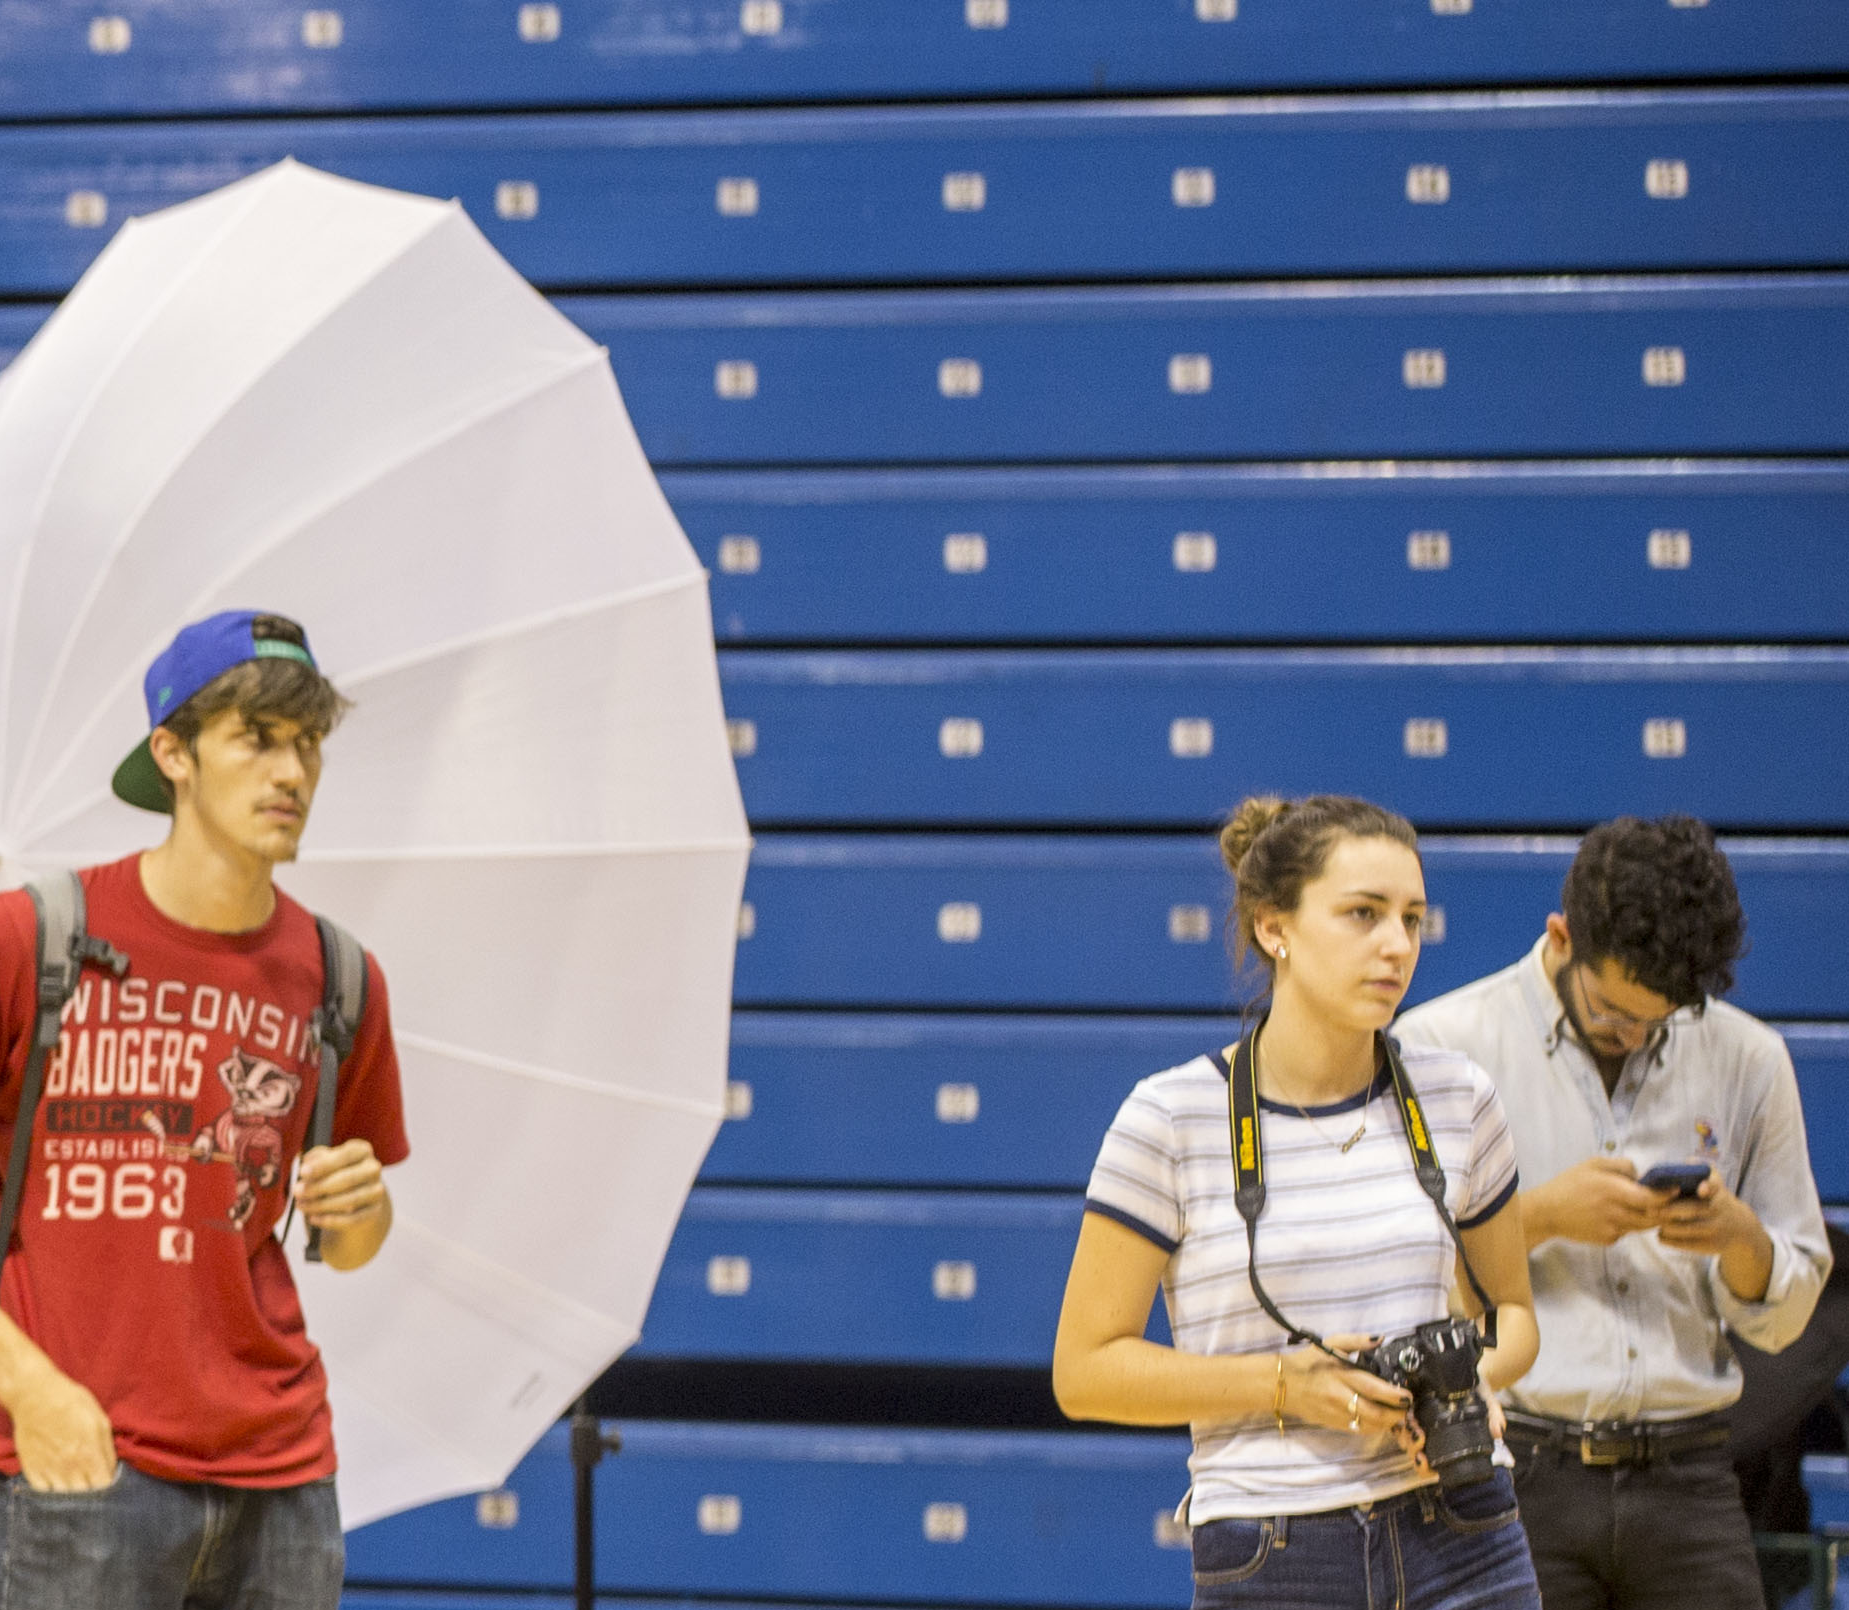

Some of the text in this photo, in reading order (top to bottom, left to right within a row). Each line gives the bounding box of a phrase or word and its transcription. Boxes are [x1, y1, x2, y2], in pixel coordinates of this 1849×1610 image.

[59, 976, 321, 1069] WISCONSIN
[45, 1027, 208, 1100] BADGERS
[41, 1163, 188, 1221] 1963
